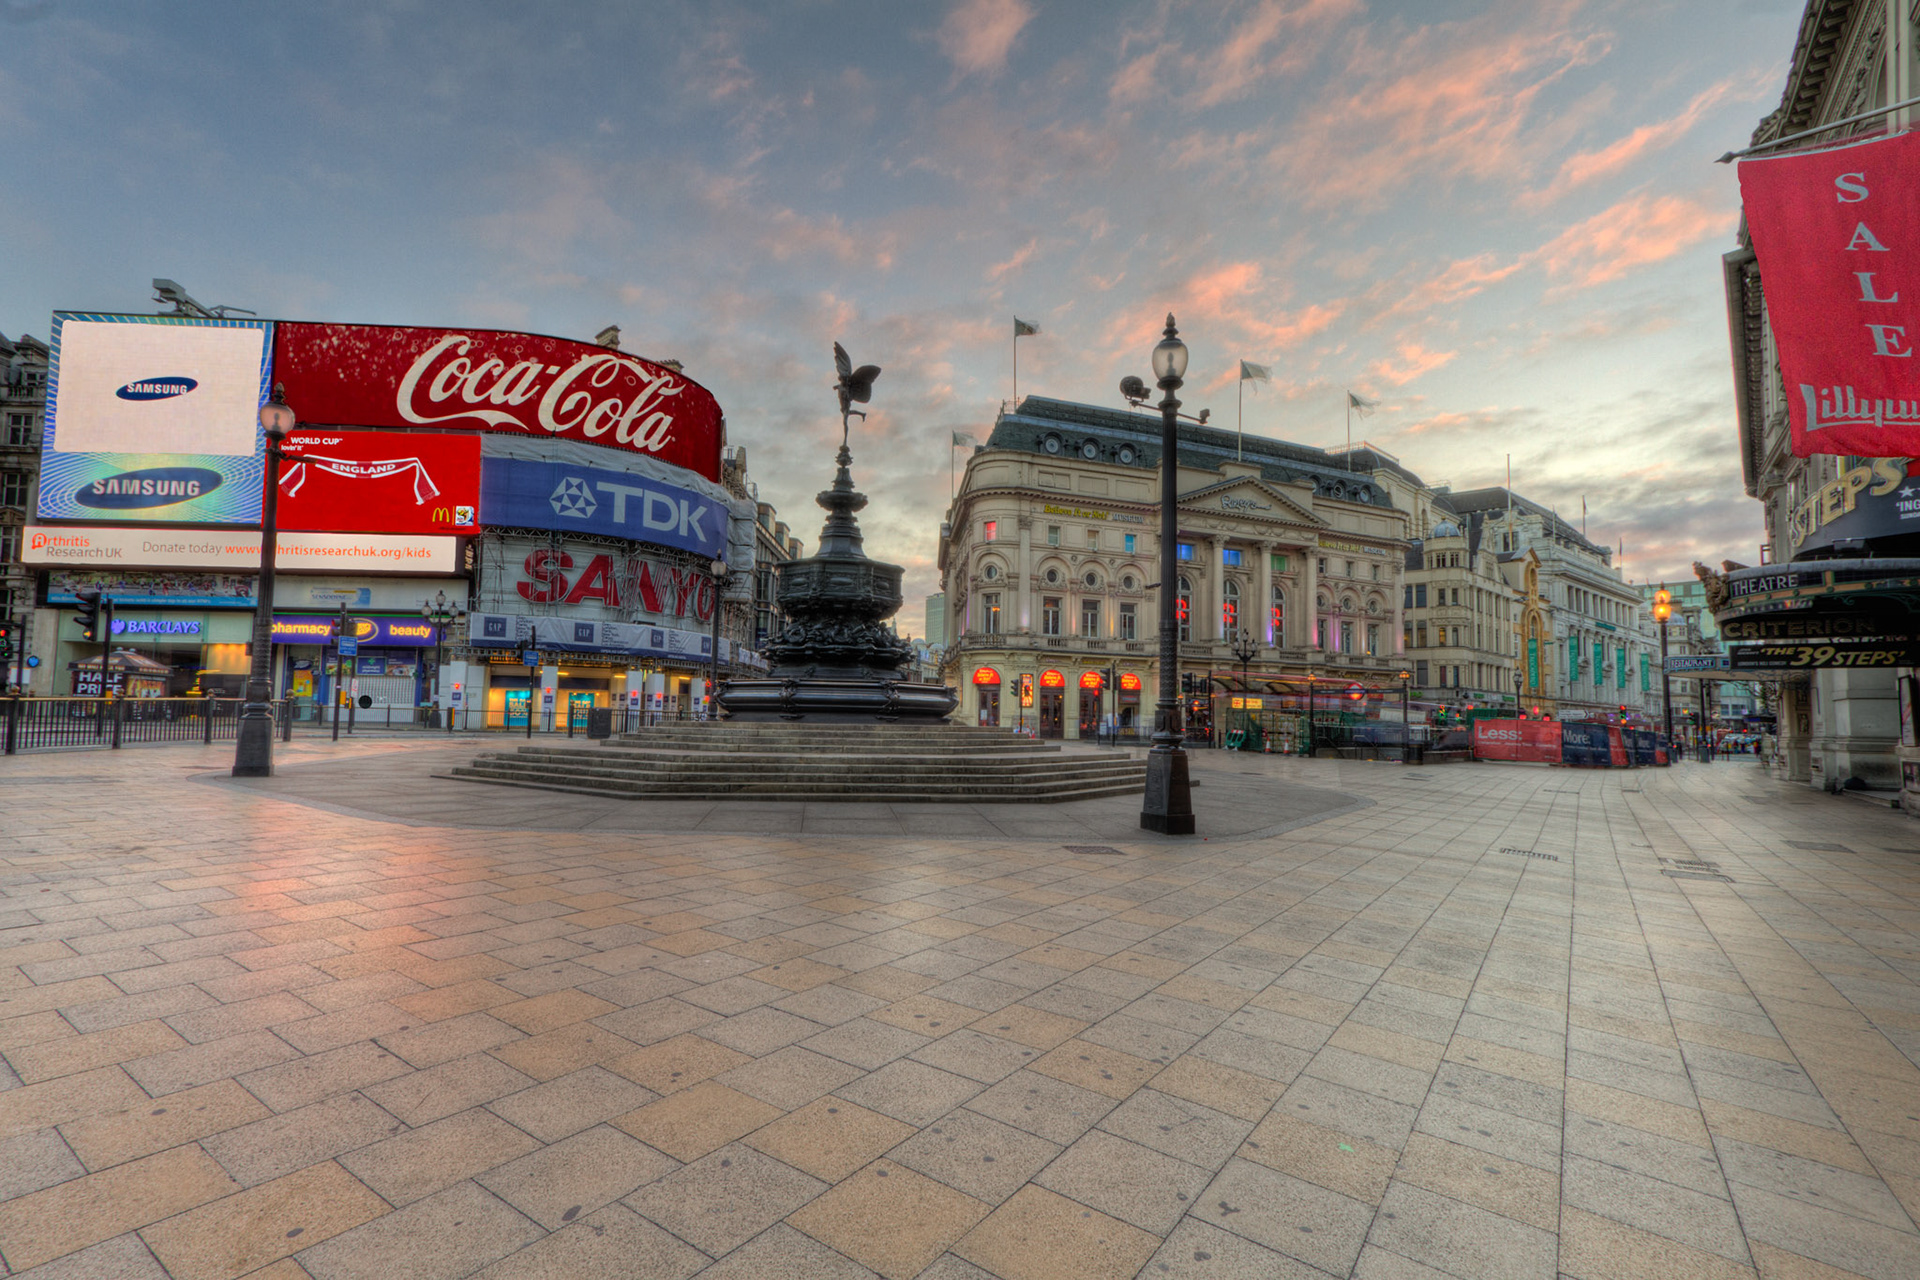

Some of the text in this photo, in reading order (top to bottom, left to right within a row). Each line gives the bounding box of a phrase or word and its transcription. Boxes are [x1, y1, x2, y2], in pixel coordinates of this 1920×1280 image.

[1834, 172, 1912, 357] SALE
[127, 382, 188, 395] SAMSUNG
[397, 335, 686, 452] Coca-Cola
[290, 437, 321, 445] WORLD
[331, 463, 396, 474] ENGLAND
[93, 479, 201, 496] SAMSUNG
[1790, 457, 1904, 548] STEPS
[596, 481, 708, 543] TDK
[1043, 504, 1072, 516] Believe
[1113, 512, 1144, 524] MUSEUM
[31, 533, 90, 550] Arthritis
[142, 541, 186, 553] Donate
[189, 543, 222, 557] today
[47, 546, 122, 558] Research UK
[516, 550, 715, 621] SANYO
[1733, 574, 1798, 597] THEATRE
[127, 620, 201, 634] BARCLAYS
[390, 624, 432, 638] beauty
[488, 623, 502, 632] GAP
[578, 628, 590, 637] GAP
[1724, 618, 1876, 638] CRITERION
[1671, 659, 1713, 668] RESTAURANT
[1790, 646, 1836, 666] 39
[80, 672, 123, 682] HALF
[77, 683, 122, 695] PRIE
[1477, 725, 1523, 741] Less:
[1563, 730, 1591, 746] More:
